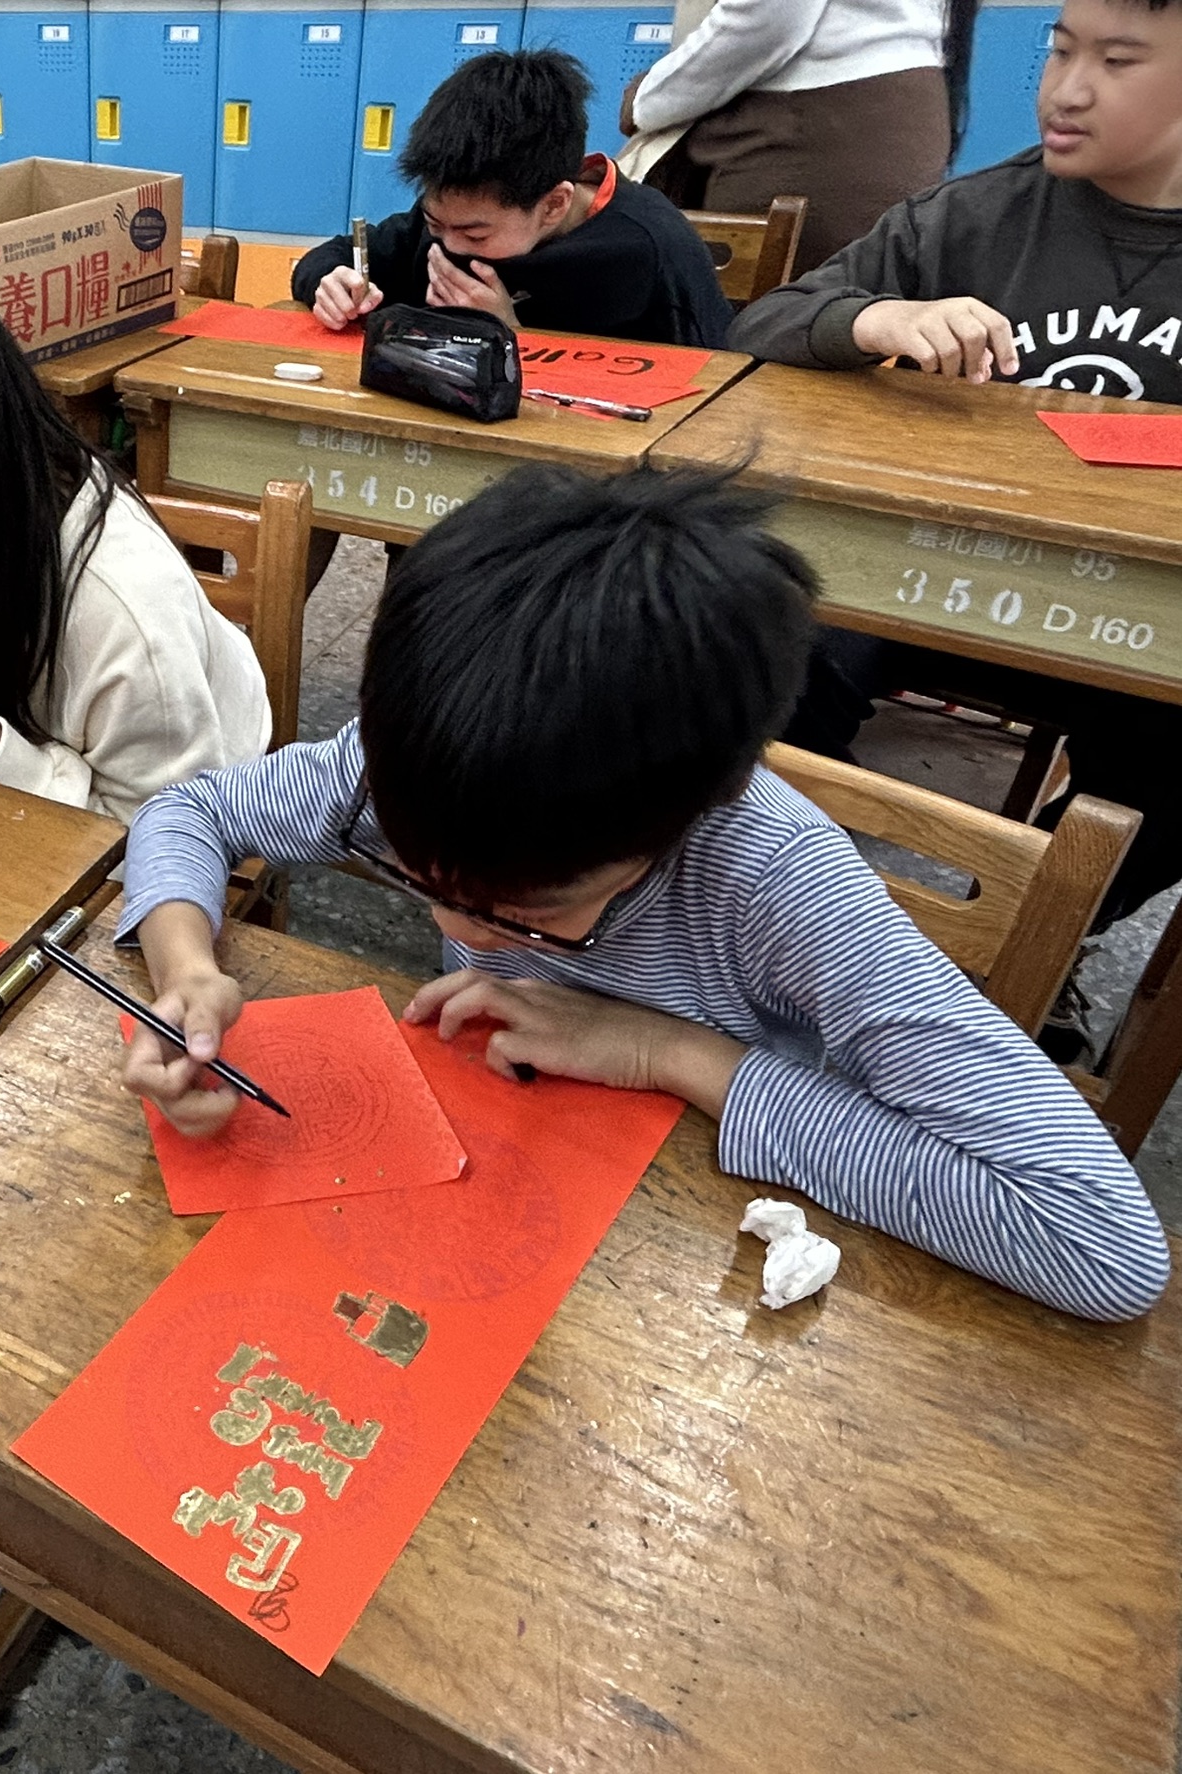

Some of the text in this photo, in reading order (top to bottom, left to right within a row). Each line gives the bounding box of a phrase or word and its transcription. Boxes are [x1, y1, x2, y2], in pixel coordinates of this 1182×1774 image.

[181, 28, 190, 39] 17
[320, 28, 330, 39] 15
[475, 29, 486, 41] 13
[650, 28, 660, 39] 11
[1013, 304, 1182, 366] HUMA
[404, 440, 432, 467] 95
[395, 485, 416, 510] D
[1070, 550, 1121, 582] 95
[1042, 602, 1077, 632] D
[1089, 613, 1155, 650] 160
